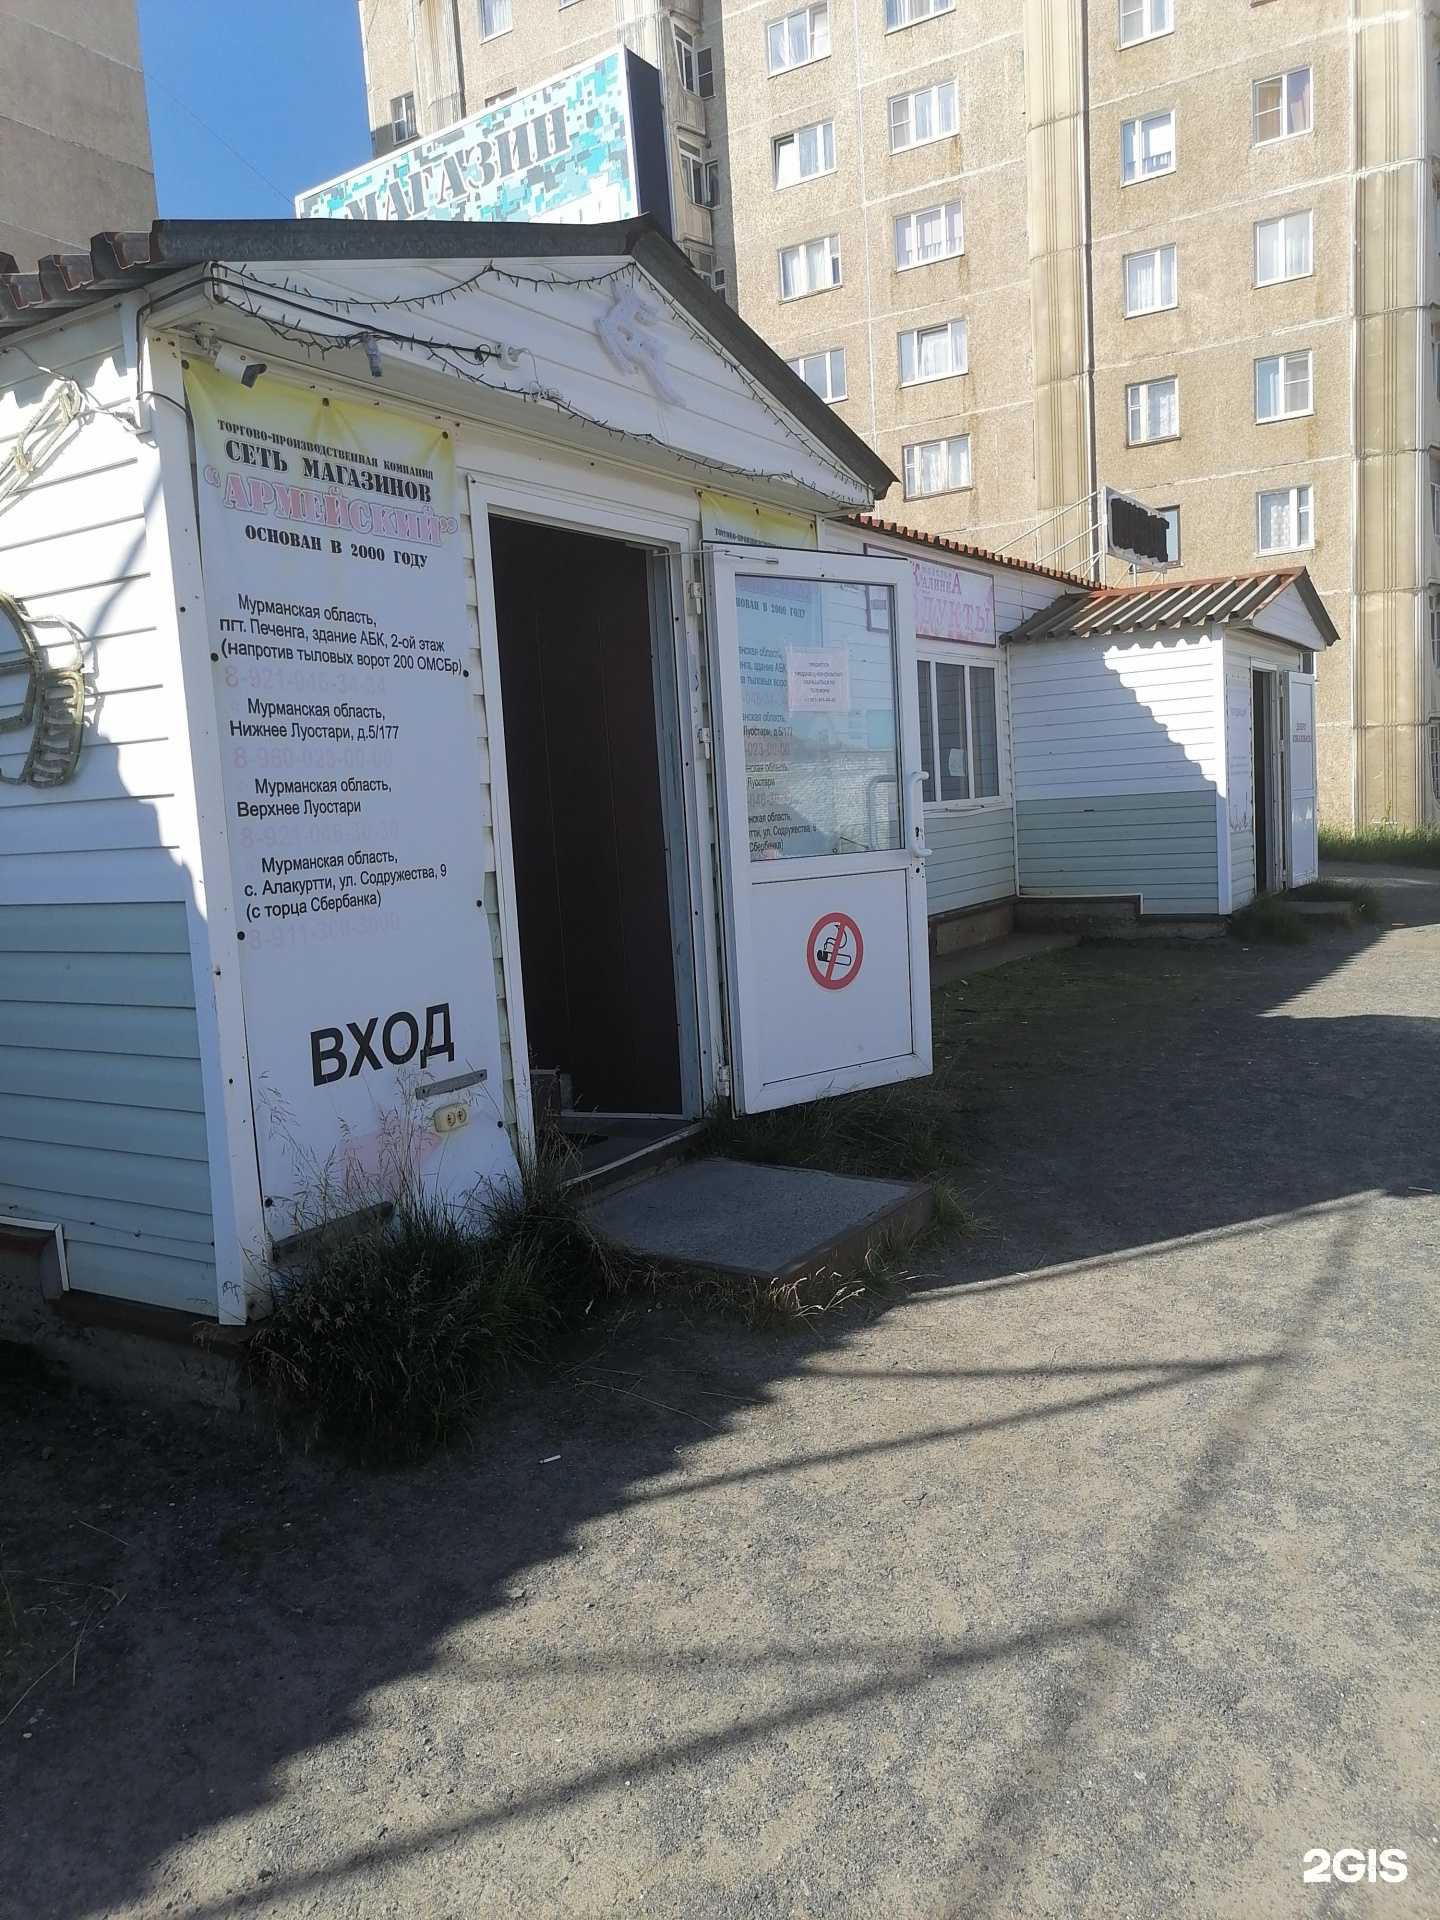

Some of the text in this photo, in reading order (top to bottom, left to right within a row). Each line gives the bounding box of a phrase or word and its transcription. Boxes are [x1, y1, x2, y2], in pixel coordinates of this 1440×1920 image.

[345, 104, 571, 221] МАГАЗИН
[218, 419, 434, 480] ТОРГОВО-ПРОИЗВОДСТВЕННАЯ КОМПАНИЯ
[225, 439, 431, 502] СЕТЬ МАГАЗИНОВ
[245, 524, 428, 569] ОСНОВАН В 2000 ГОДУ
[237, 593, 377, 627] Мурманская область,
[250, 619, 309, 641] Печенга,
[312, 629, 357, 644] здание
[360, 631, 388, 649] АБК,
[390, 634, 416, 651] 2-ой
[418, 640, 445, 652] этаж
[221, 639, 462, 675] (напротив тыловых ворот 200 ОМСБр)
[247, 698, 386, 720] Мурманская область,
[230, 720, 399, 742] Нижнее Луостари, д.5/177
[255, 778, 392, 796] Мурманская область,
[237, 799, 361, 819] Верхнее Луостари
[261, 848, 398, 876] Мурманская область,
[244, 863, 447, 899] с. Алакуртти, ул. Содружества, 9
[246, 890, 382, 923] (с торца Сбербанка)
[310, 1002, 455, 1087] ВХОД
